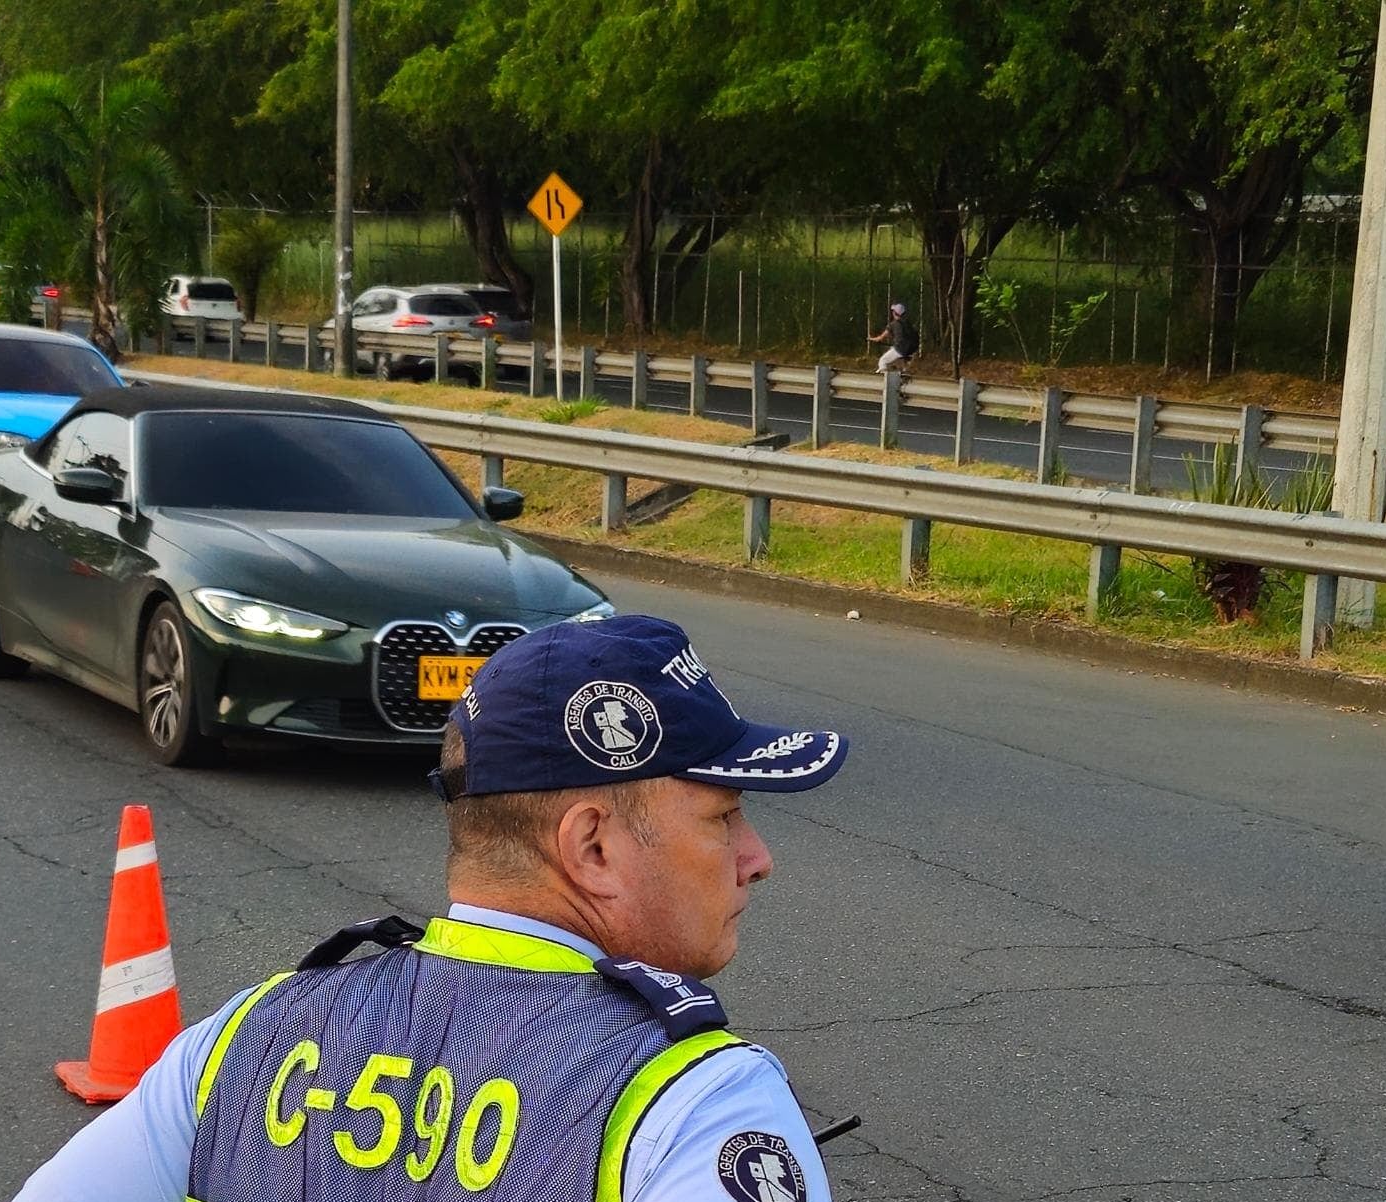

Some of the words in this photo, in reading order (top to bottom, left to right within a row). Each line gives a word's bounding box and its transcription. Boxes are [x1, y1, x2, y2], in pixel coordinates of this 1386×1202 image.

[568, 689, 593, 730] AGENTES
[593, 684, 610, 696] DE
[611, 685, 655, 722] TRANSITO
[609, 753, 638, 768] CALI
[264, 1039, 521, 1192] C-590
[719, 1135, 747, 1179] AGENTES
[748, 1133, 766, 1145] DE
